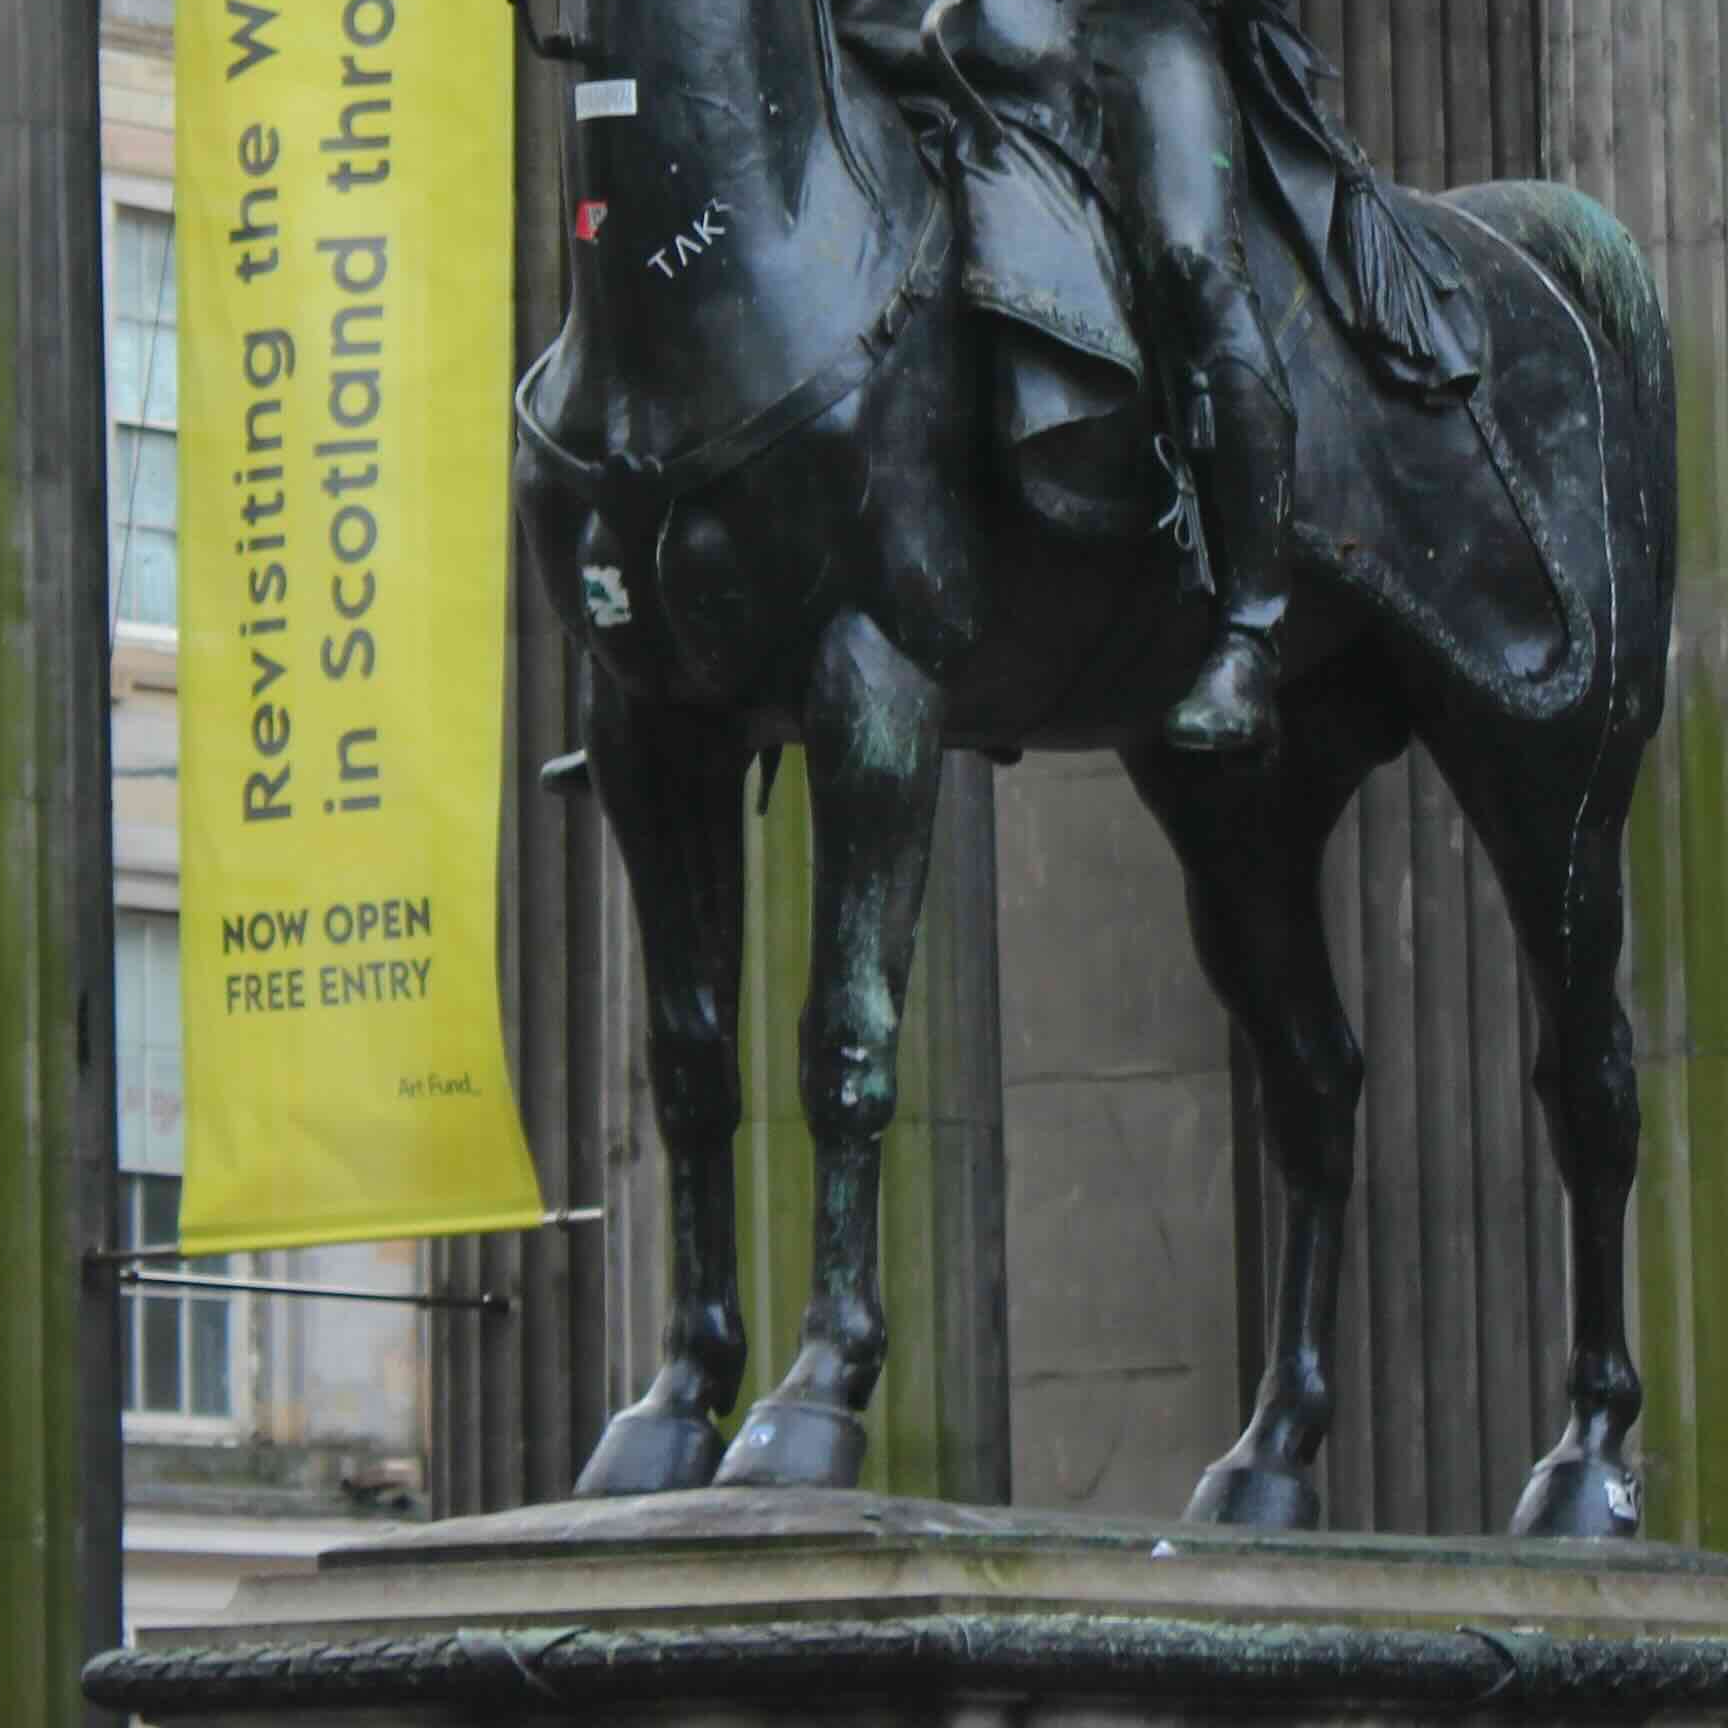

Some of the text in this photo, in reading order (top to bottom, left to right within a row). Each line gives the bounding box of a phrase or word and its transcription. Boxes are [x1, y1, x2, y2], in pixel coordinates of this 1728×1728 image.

[229, 123, 280, 285] the
[313, 236, 388, 681] Scotland
[232, 327, 296, 823] Revisiting
[323, 725, 382, 814] in
[223, 896, 432, 956] NOW OPEN
[226, 958, 432, 1016] FREE ENTRY
[398, 1076, 423, 1098] Art
